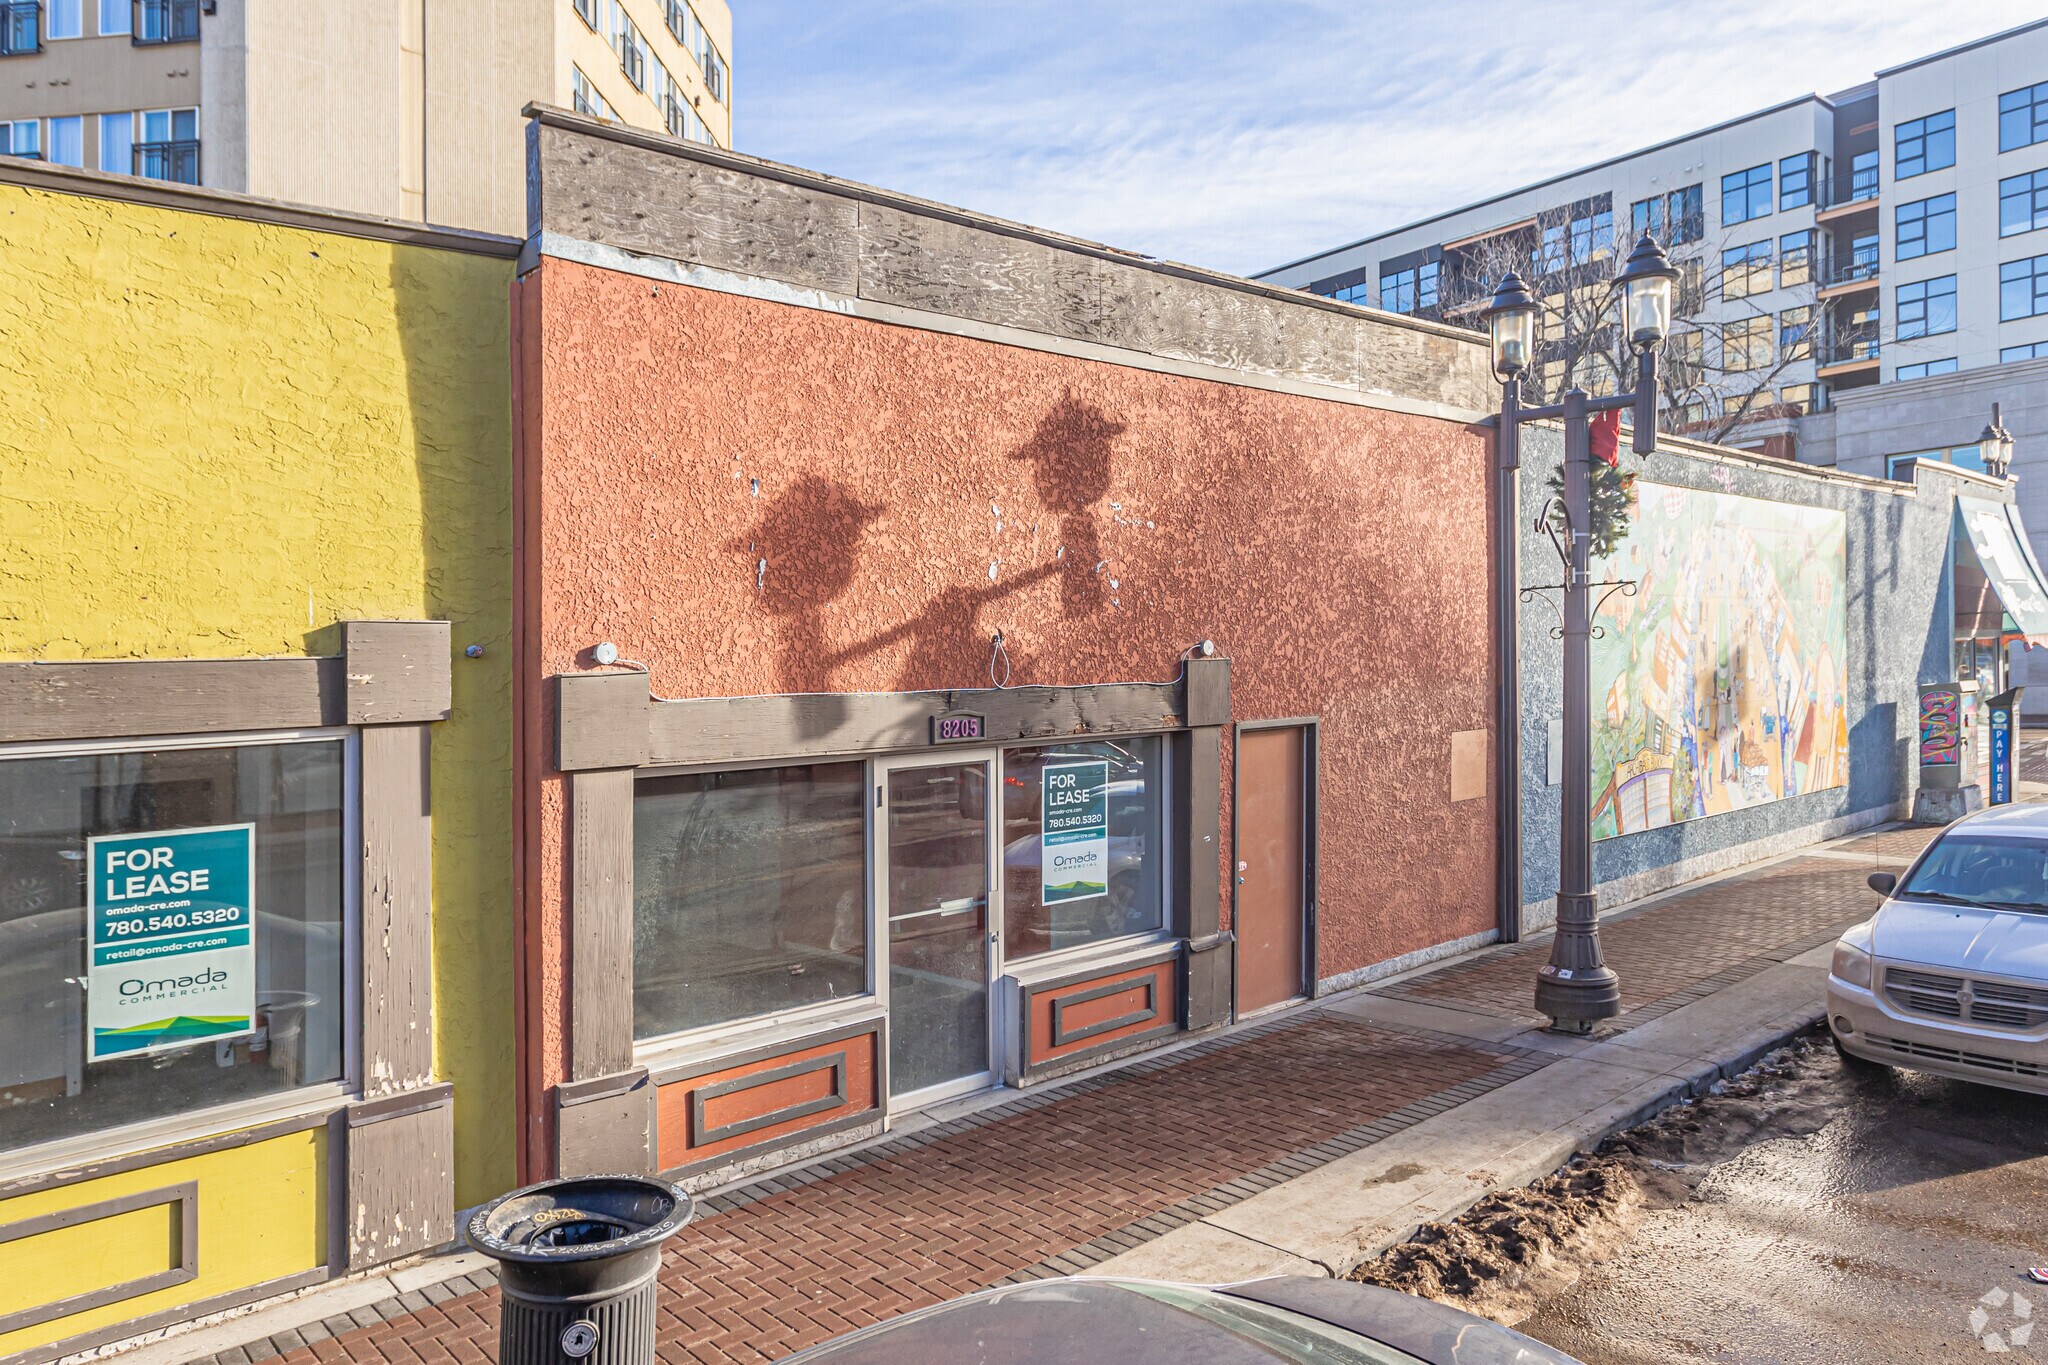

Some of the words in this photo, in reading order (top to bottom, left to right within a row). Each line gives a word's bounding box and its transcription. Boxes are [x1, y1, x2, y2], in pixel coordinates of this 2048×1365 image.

[943, 719, 978, 738] 8205
[1049, 773, 1076, 789] FOR
[1996, 764, 2004, 802] HERE
[1049, 789, 1090, 806] LEASE
[1049, 807, 1083, 816] omada-cre.com
[1049, 814, 1102, 829] 780.540.5320
[1049, 832, 1097, 843] retail@omada-cre.com
[106, 847, 175, 874] FOR
[1053, 863, 1097, 872] COMMERCIAL
[1054, 851, 1098, 867] Omada
[106, 869, 210, 901] LEASE
[105, 899, 191, 916] omada-cre.com
[105, 907, 240, 937] 780.540.5320
[105, 936, 228, 961] retail@omada-cre.com
[119, 967, 228, 996] Omada
[119, 984, 228, 1006] COMMERCIAL
